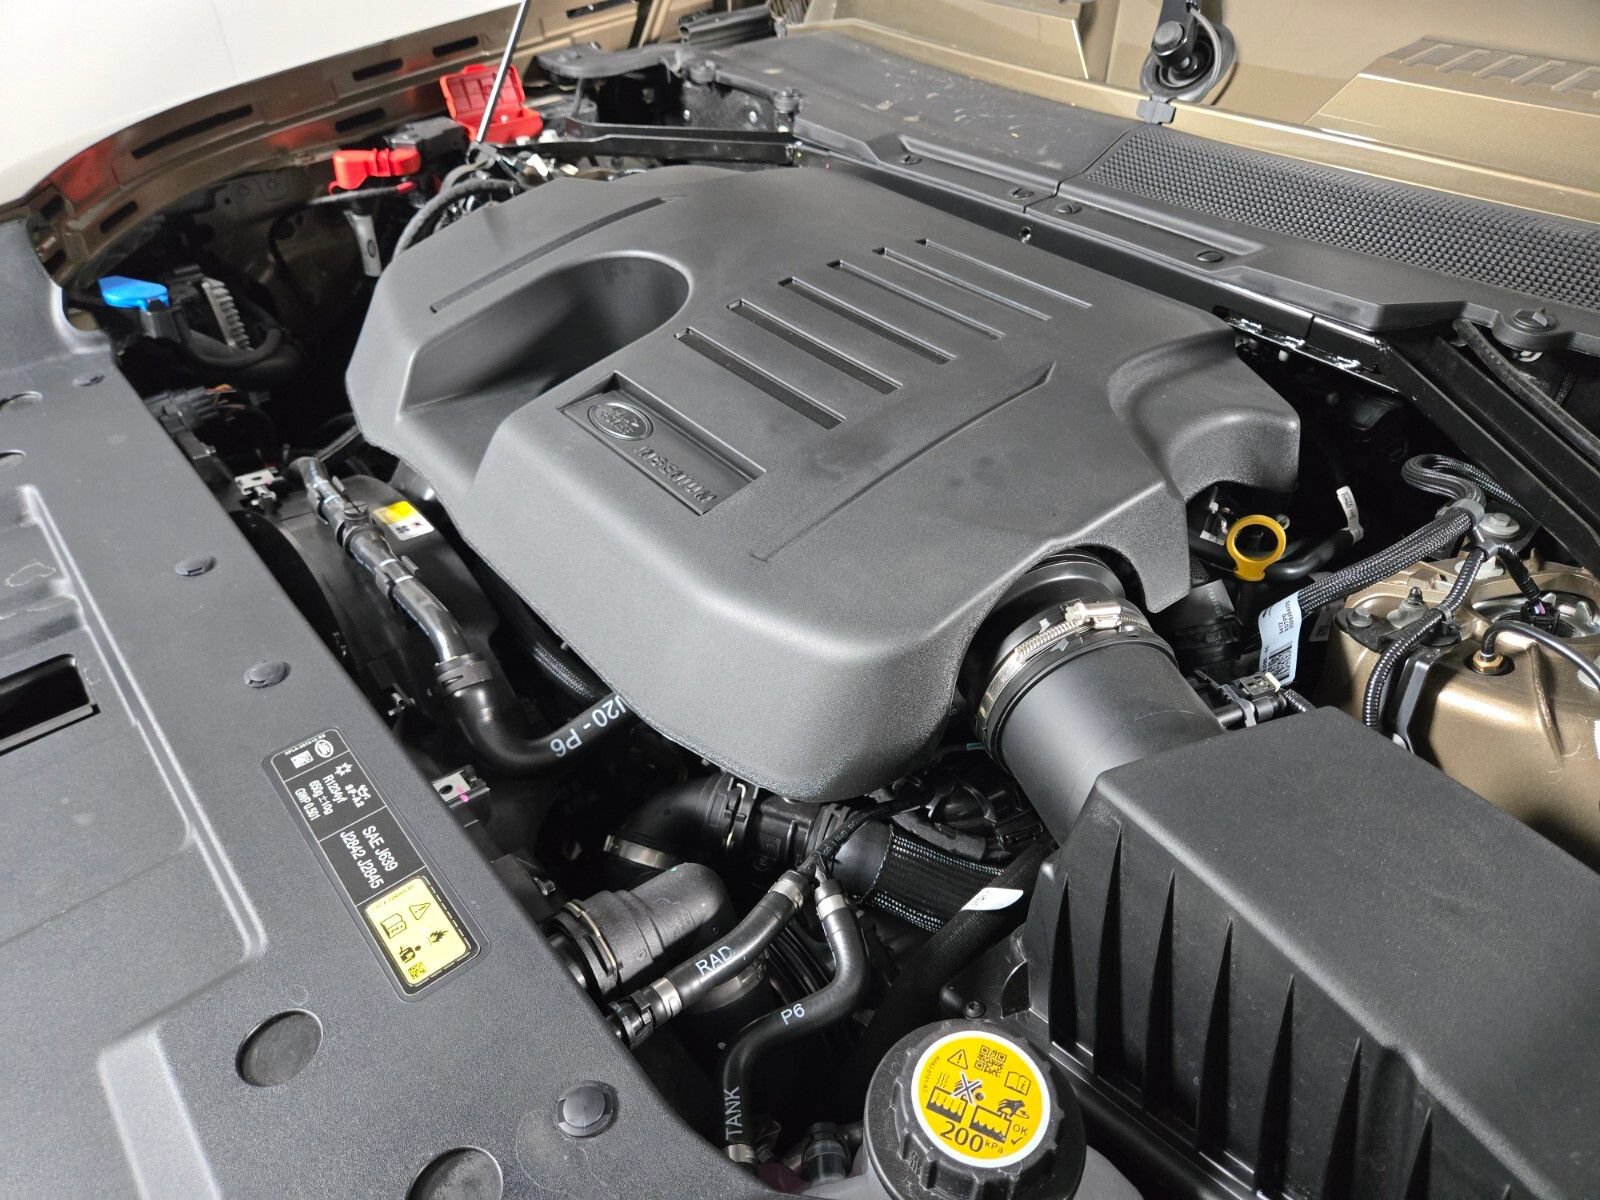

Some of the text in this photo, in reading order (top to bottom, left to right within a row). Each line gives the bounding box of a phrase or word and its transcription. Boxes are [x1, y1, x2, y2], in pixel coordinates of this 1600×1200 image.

[550, 728, 582, 757] P6
[322, 775, 348, 804] R1234yf
[340, 831, 385, 889] J2842 J2845
[362, 825, 384, 851] SAE
[375, 848, 399, 872] J639
[695, 946, 735, 976] RAD
[780, 1003, 805, 1026] P6
[724, 1086, 743, 1140] TANK
[940, 1120, 1004, 1154] 200 kPa
[1013, 1123, 1028, 1136] OK
